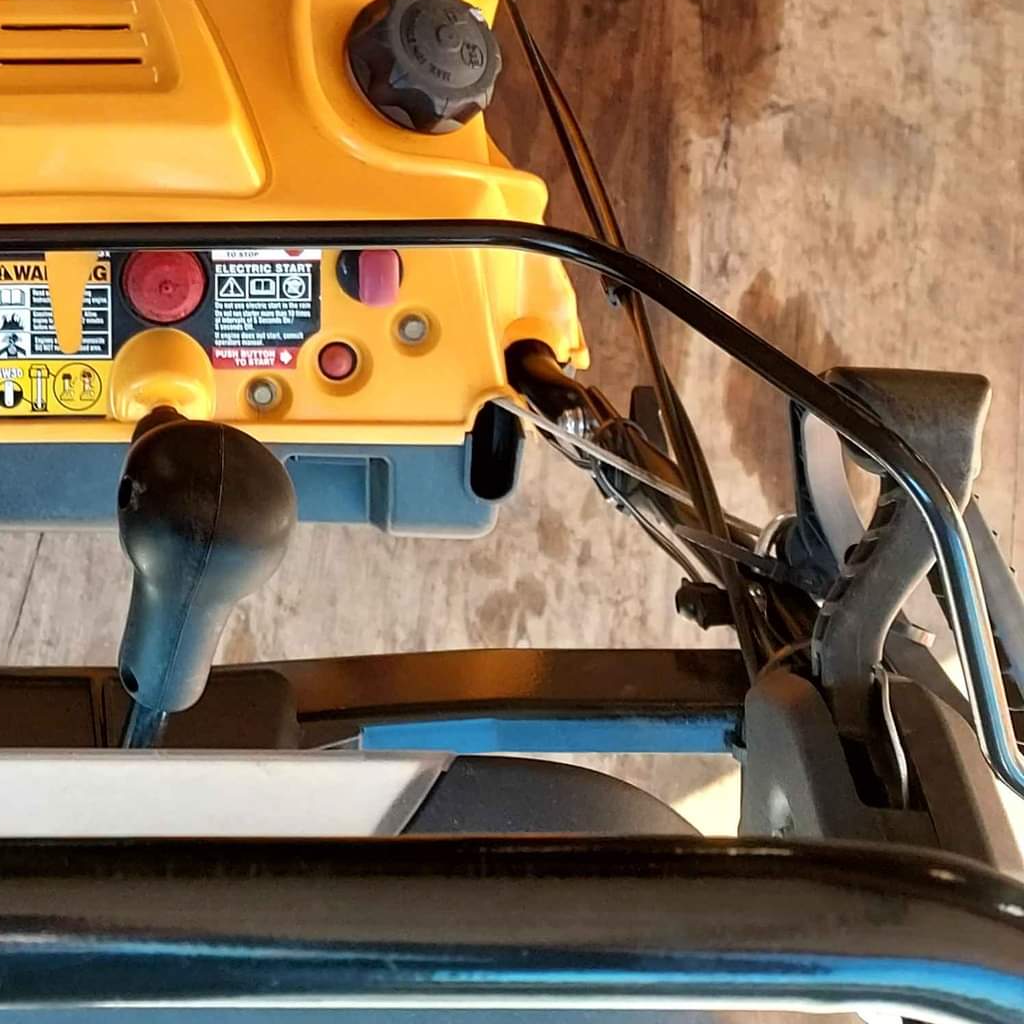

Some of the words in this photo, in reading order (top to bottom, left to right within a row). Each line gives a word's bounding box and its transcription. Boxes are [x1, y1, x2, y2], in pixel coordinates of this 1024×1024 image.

[215, 264, 272, 273] ELECTRIC
[275, 264, 312, 272] START
[215, 350, 239, 359] PUSH
[240, 350, 275, 358] BUTTON
